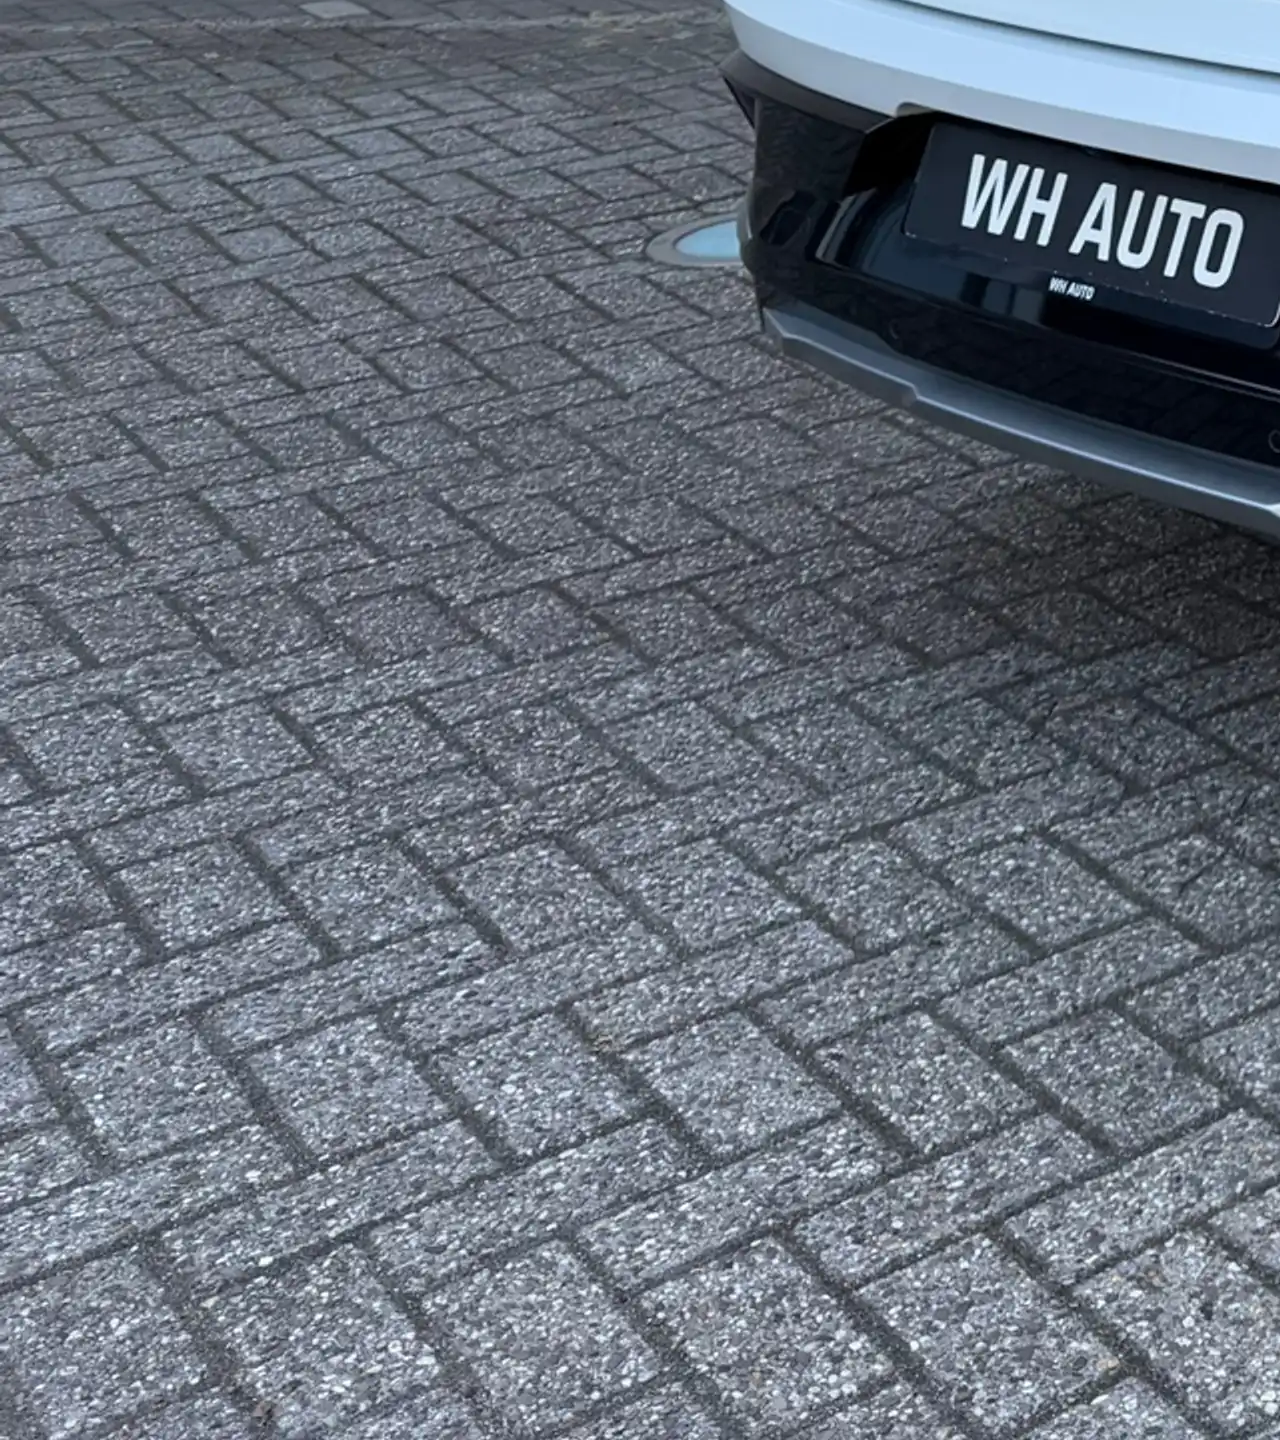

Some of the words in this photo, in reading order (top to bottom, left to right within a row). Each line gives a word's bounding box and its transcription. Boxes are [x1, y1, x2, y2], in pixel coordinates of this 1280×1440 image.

[961, 153, 1069, 247] WH
[1069, 182, 1245, 289] AUTO
[1049, 276, 1069, 295] WH
[1066, 282, 1096, 301] AUTO
